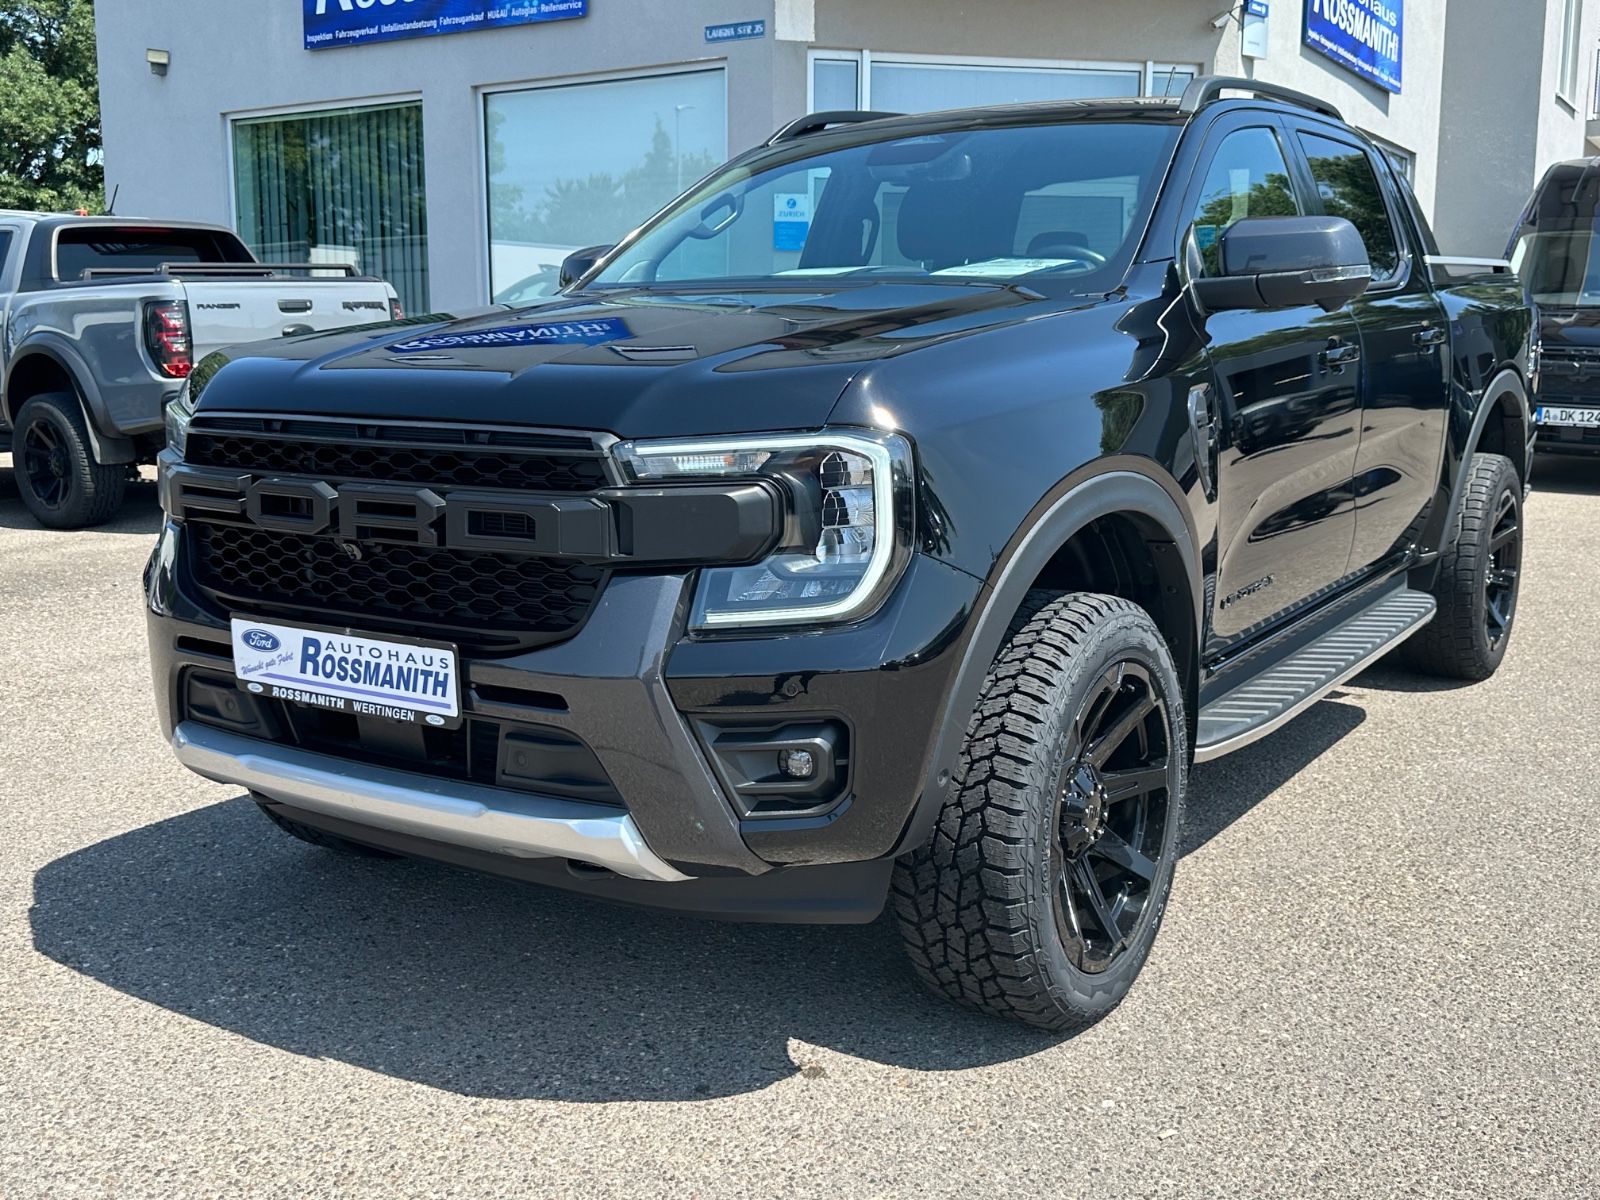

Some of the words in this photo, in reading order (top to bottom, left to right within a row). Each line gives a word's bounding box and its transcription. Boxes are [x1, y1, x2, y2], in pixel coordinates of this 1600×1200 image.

[1544, 409, 1551, 422] A
[1560, 410, 1576, 422] DK
[166, 464, 606, 559] FORD
[249, 631, 273, 648] Ford
[325, 640, 449, 669] AUTOHAUS
[300, 636, 449, 698] ROSSMANITH
[272, 686, 345, 709] ROSSMANITH
[353, 701, 415, 722] WERTINGEN
